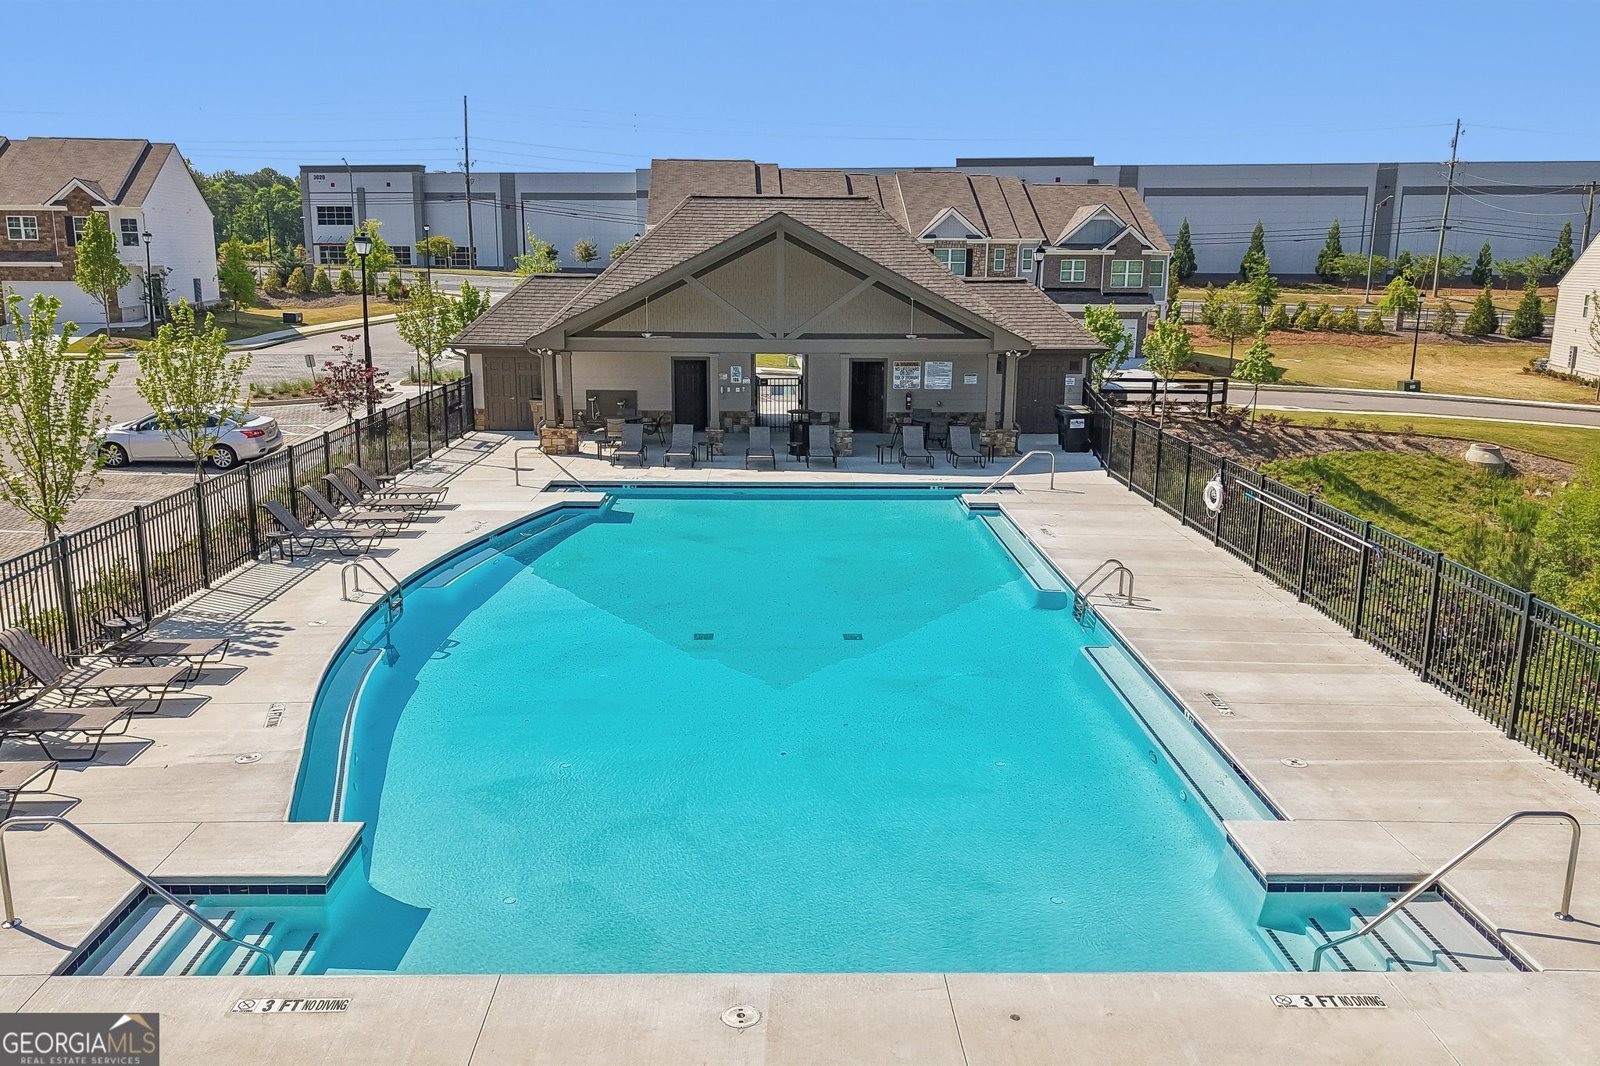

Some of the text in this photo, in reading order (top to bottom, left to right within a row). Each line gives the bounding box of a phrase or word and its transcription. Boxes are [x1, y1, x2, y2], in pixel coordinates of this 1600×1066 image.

[262, 999, 349, 1012] 3 FT NO DIVING
[1300, 995, 1386, 1007] 3 FT NO DIVING
